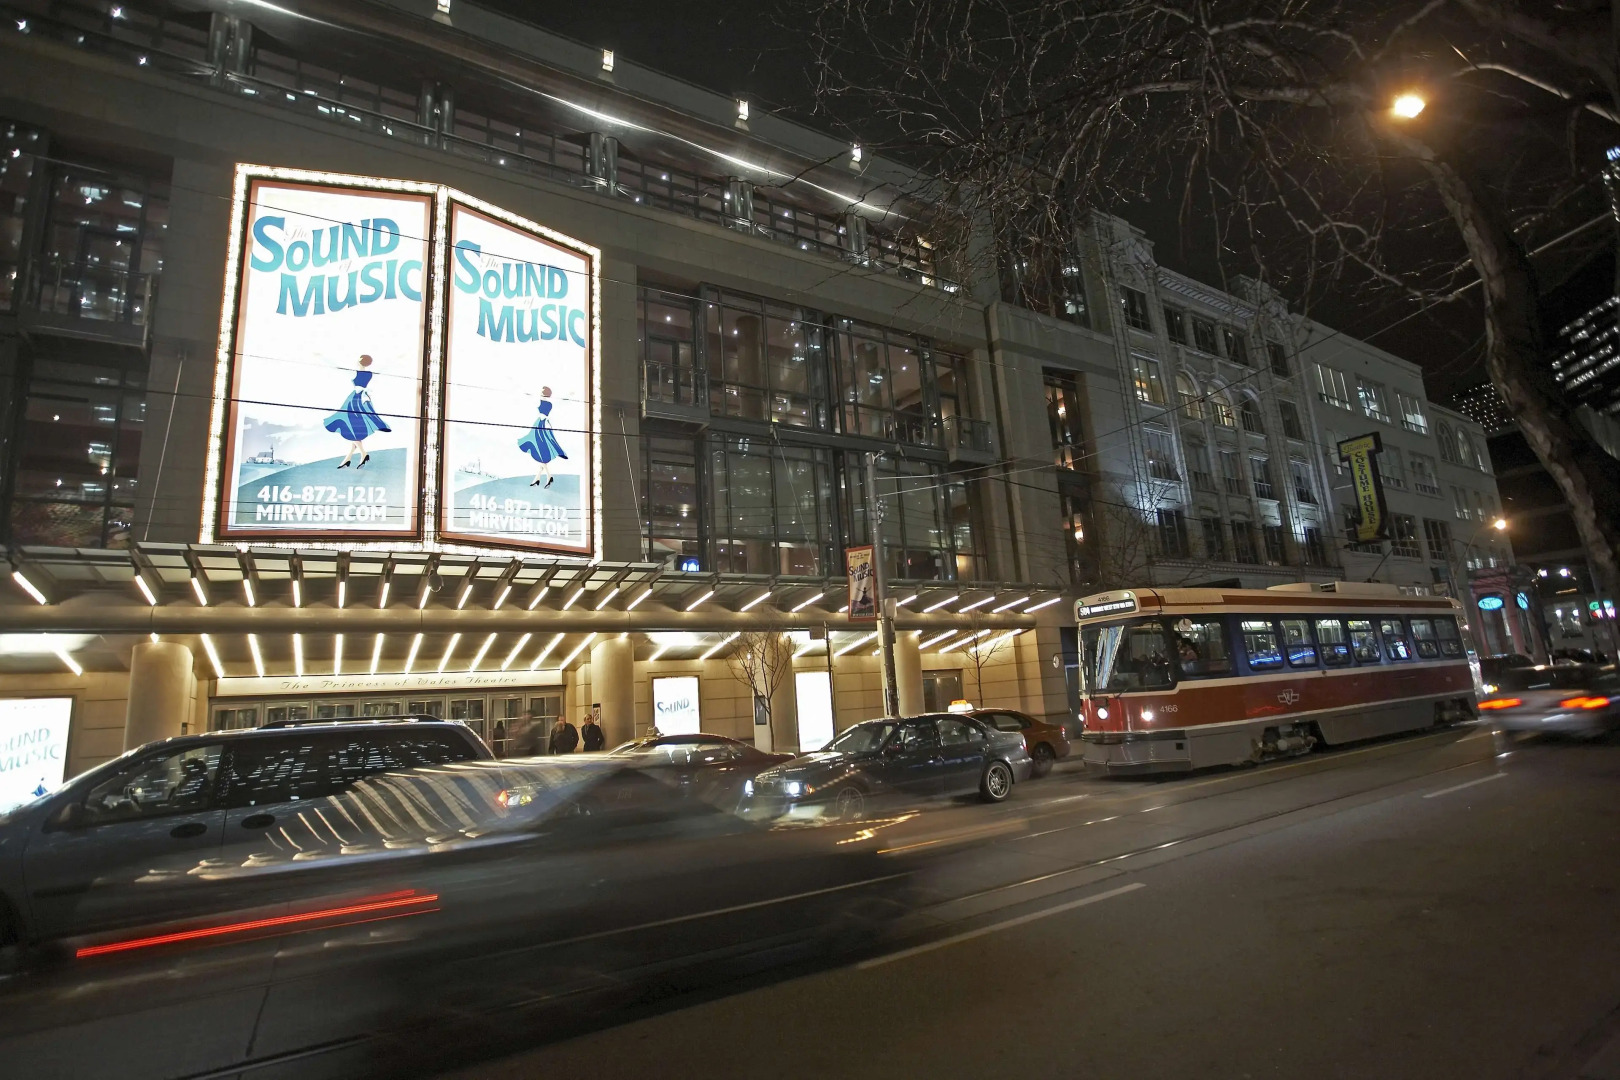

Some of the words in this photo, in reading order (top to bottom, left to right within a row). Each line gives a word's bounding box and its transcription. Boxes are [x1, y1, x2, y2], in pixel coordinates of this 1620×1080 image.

[275, 259, 423, 318] MUSIC
[476, 296, 586, 348] MUSIC
[256, 485, 387, 503] 416-872-1212
[1355, 451, 1370, 492] COSTUME
[1363, 494, 1377, 524] HOUSE
[255, 504, 387, 522] MIRVISH.COM
[469, 493, 568, 522] 416-872-1212
[469, 511, 569, 537] MIRVISH.COM
[280, 682, 310, 690] The
[322, 679, 386, 689] Princess
[394, 678, 410, 687] of
[417, 677, 457, 686] Wales
[465, 676, 517, 684] Theatre
[1160, 704, 1179, 713] 4166
